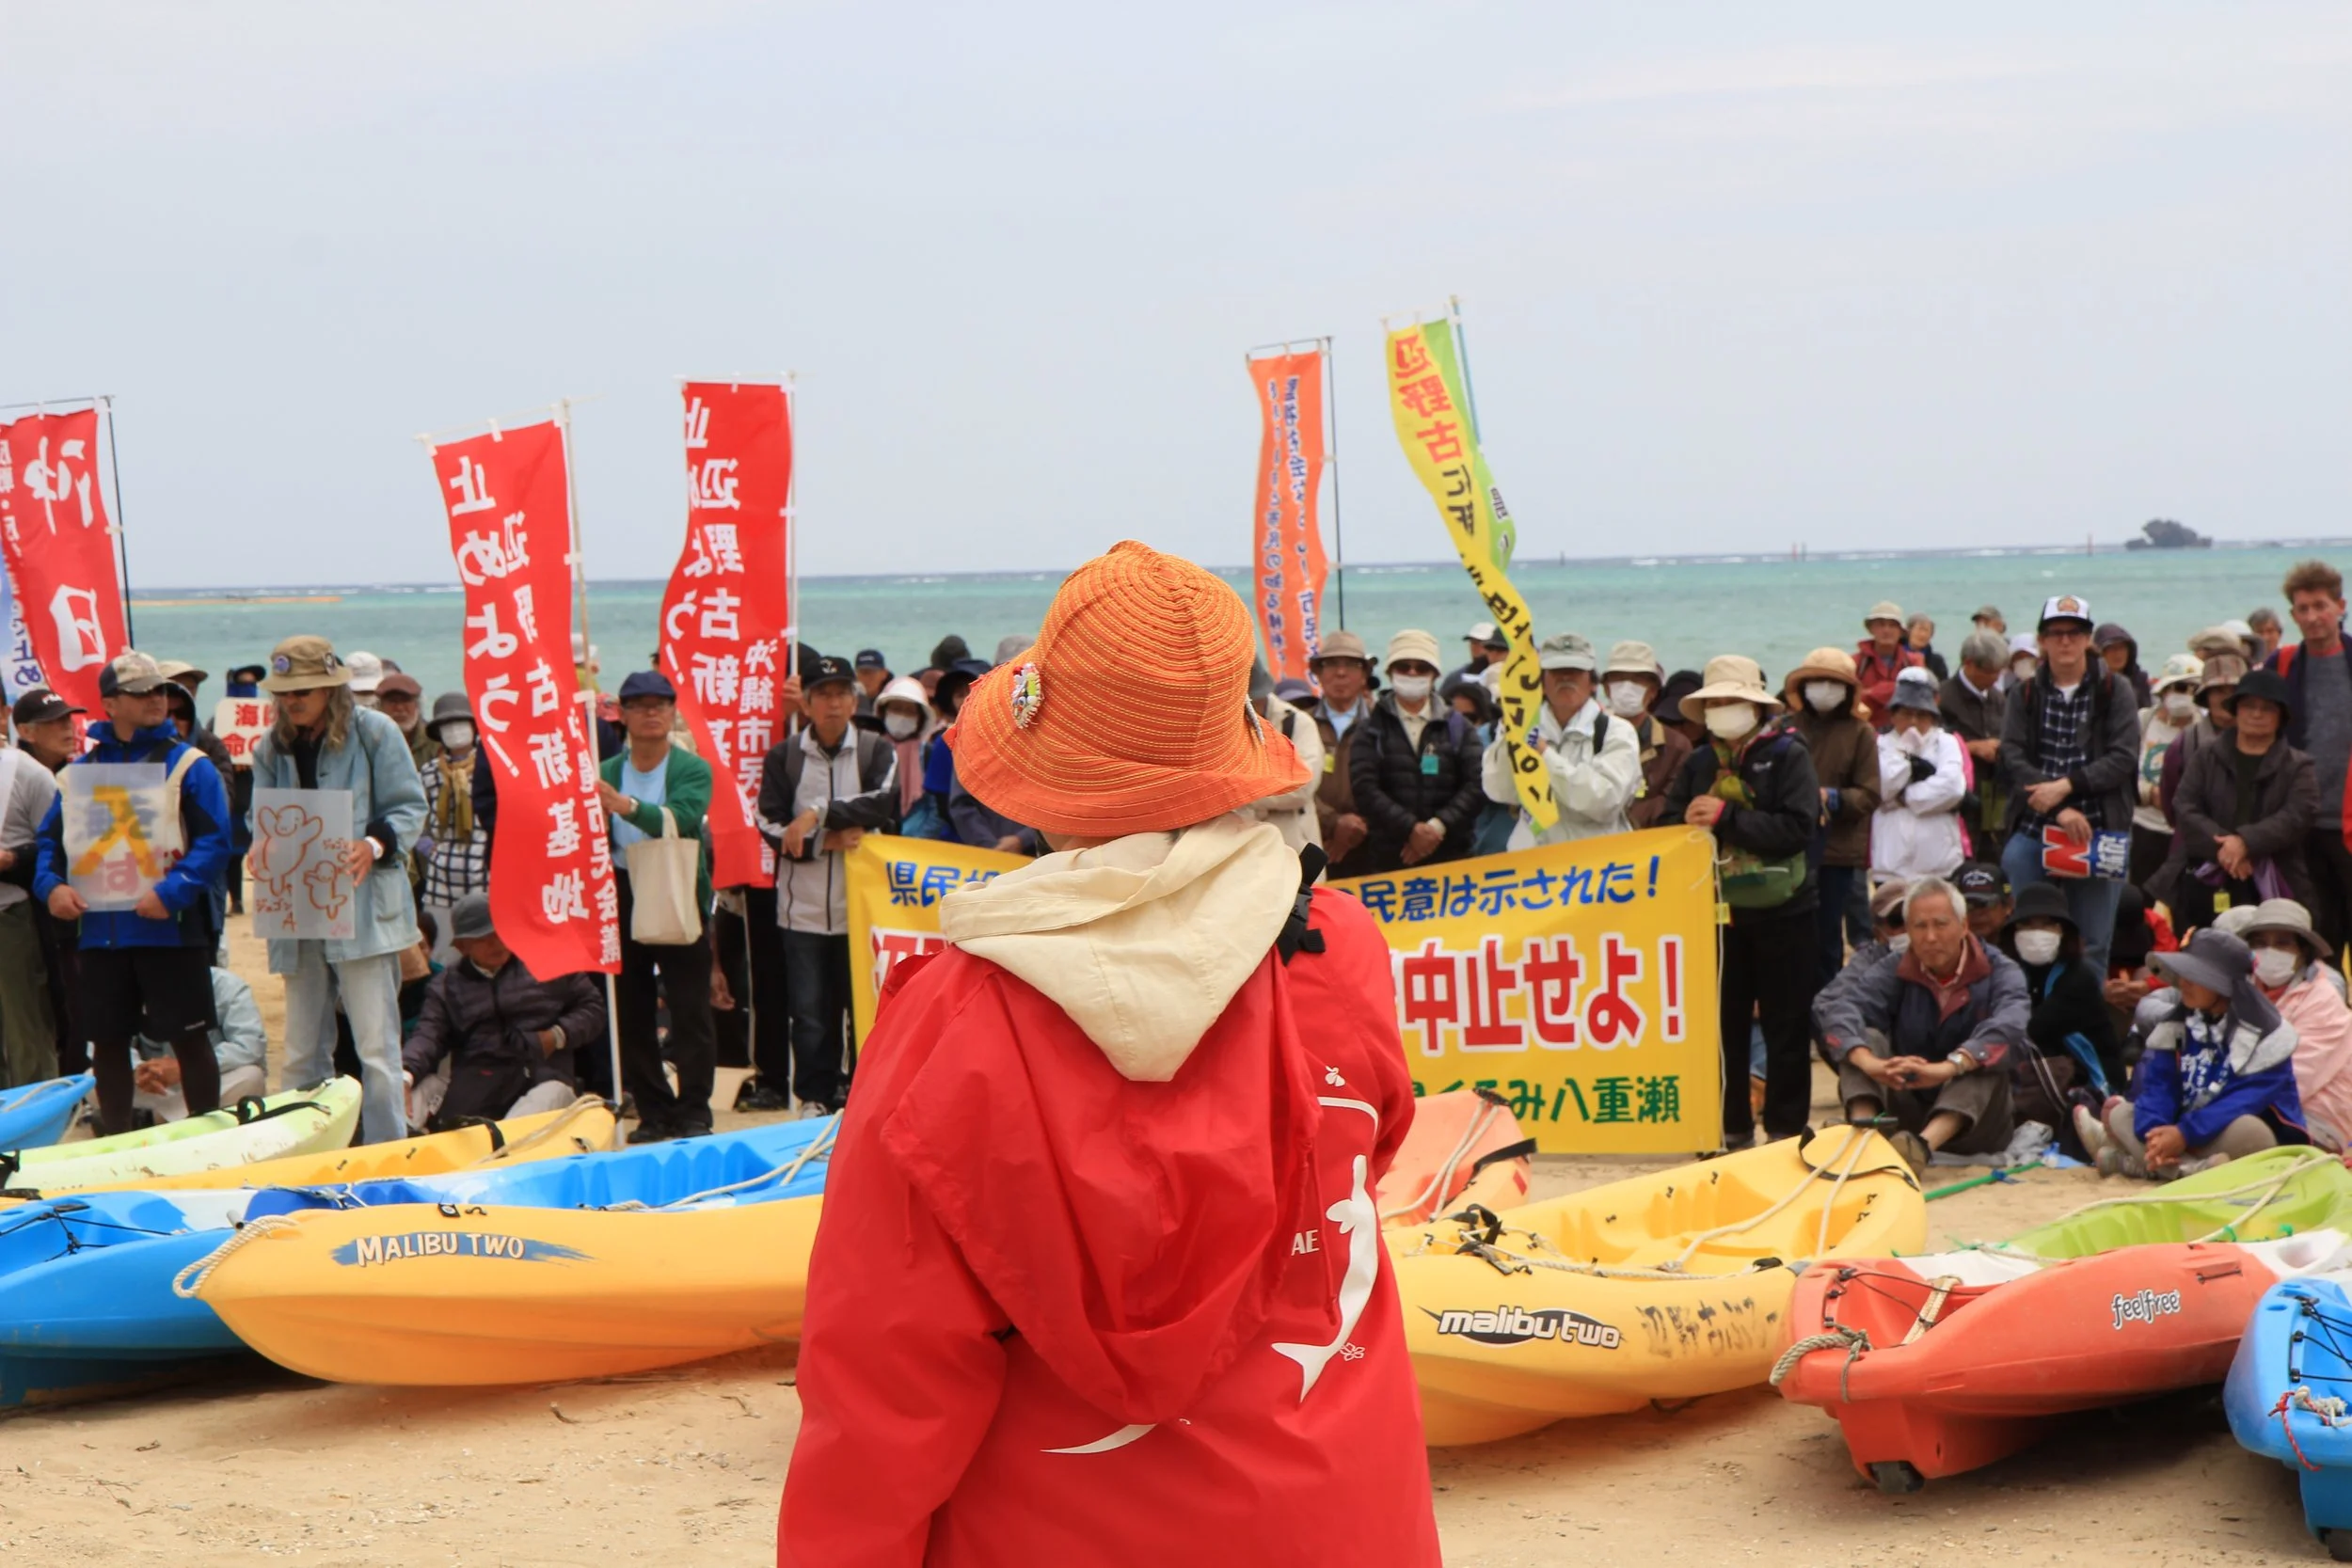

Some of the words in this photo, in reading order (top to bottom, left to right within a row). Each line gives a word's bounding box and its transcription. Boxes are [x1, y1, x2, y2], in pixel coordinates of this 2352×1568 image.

[356, 1232, 459, 1267] MALIBU
[466, 1233, 525, 1259] TWO
[1438, 1305, 1558, 1339] malibu
[1559, 1313, 1622, 1350] two
[2111, 1289, 2180, 1330] feelfree
